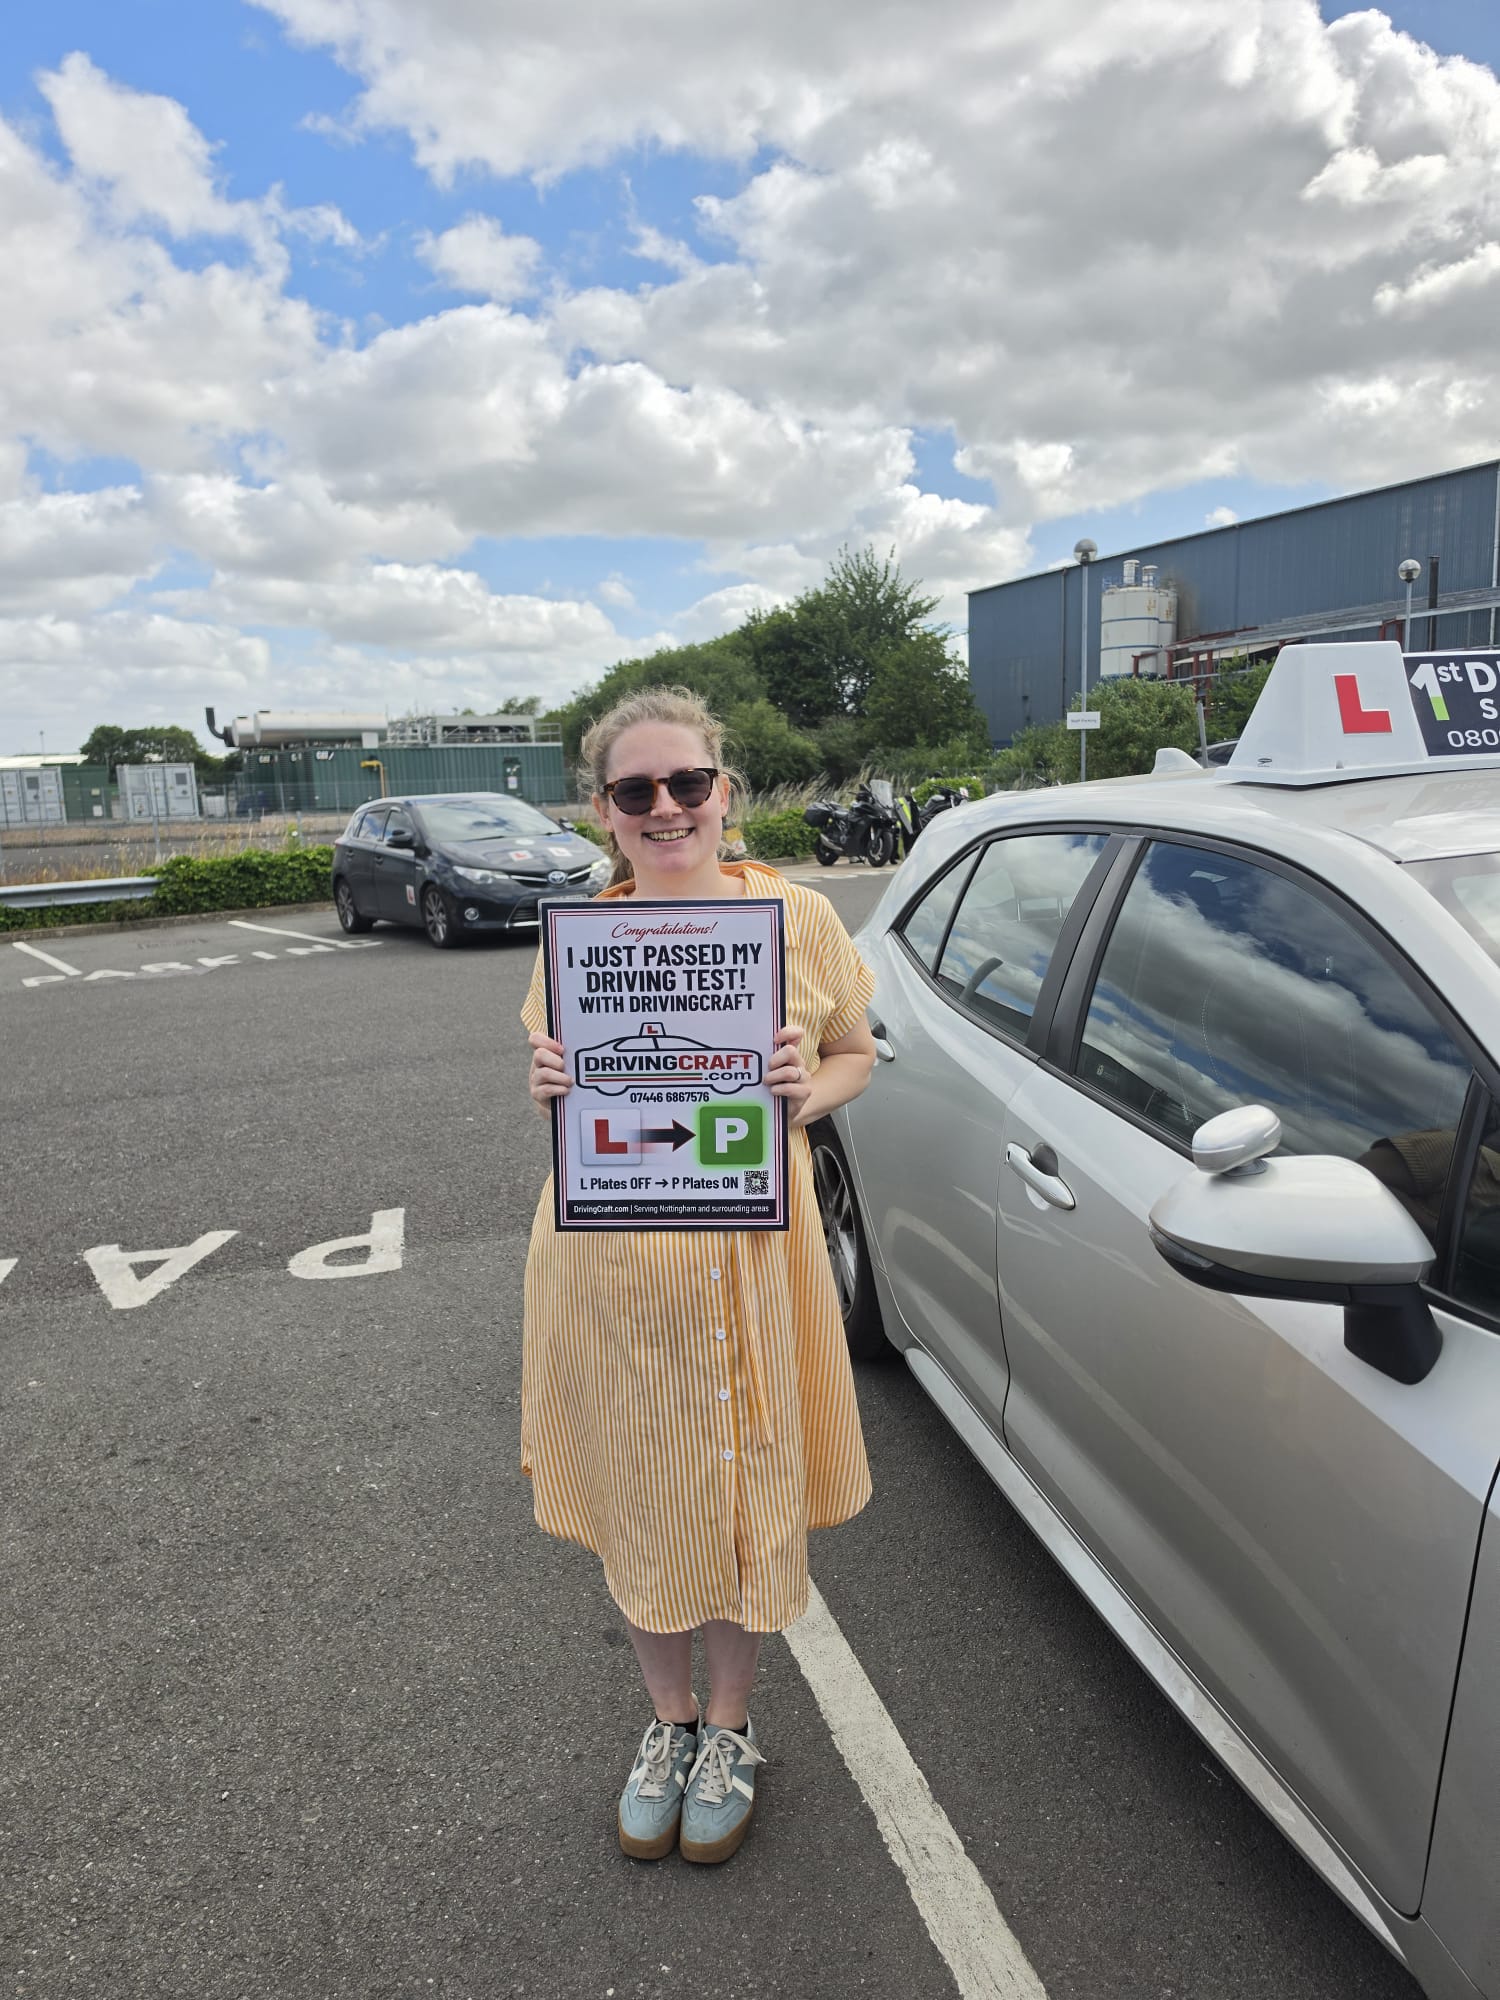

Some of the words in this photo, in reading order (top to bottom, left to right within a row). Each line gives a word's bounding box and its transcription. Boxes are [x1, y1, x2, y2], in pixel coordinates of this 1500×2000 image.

[1410, 662, 1464, 721] 1st
[1464, 660, 1500, 694] D
[1334, 674, 1393, 734] L
[1447, 728, 1500, 748] 080
[611, 921, 718, 943] Congratulations!
[22, 937, 384, 988] PARKING
[567, 946, 574, 968] I
[580, 945, 636, 968] JUST
[643, 943, 726, 967] PASSED
[732, 942, 763, 965] MY
[586, 970, 677, 993] DRIVING
[682, 968, 746, 991] TEST!
[578, 995, 625, 1014] WITH
[629, 993, 755, 1013] DRIVINGCRAFT
[646, 1025, 658, 1035] L
[584, 1054, 754, 1072] DRIVINGCRAFT
[704, 1071, 752, 1081] .com
[630, 1092, 664, 1103] 07446
[665, 1091, 710, 1103] 6867576
[594, 1118, 628, 1154] L
[714, 1117, 749, 1154] P
[580, 1178, 588, 1190] L
[590, 1177, 628, 1190] Plates
[630, 1177, 652, 1190] OFF
[672, 1177, 680, 1190] P
[682, 1176, 720, 1190] Plates
[722, 1176, 739, 1189] ON
[573, 1204, 629, 1215] DrivingCraft.com
[633, 1204, 658, 1214] Serving
[659, 1204, 697, 1214] Nottingham
[698, 1204, 710, 1213] and
[711, 1204, 750, 1214] surrounding
[751, 1205, 770, 1213] areas
